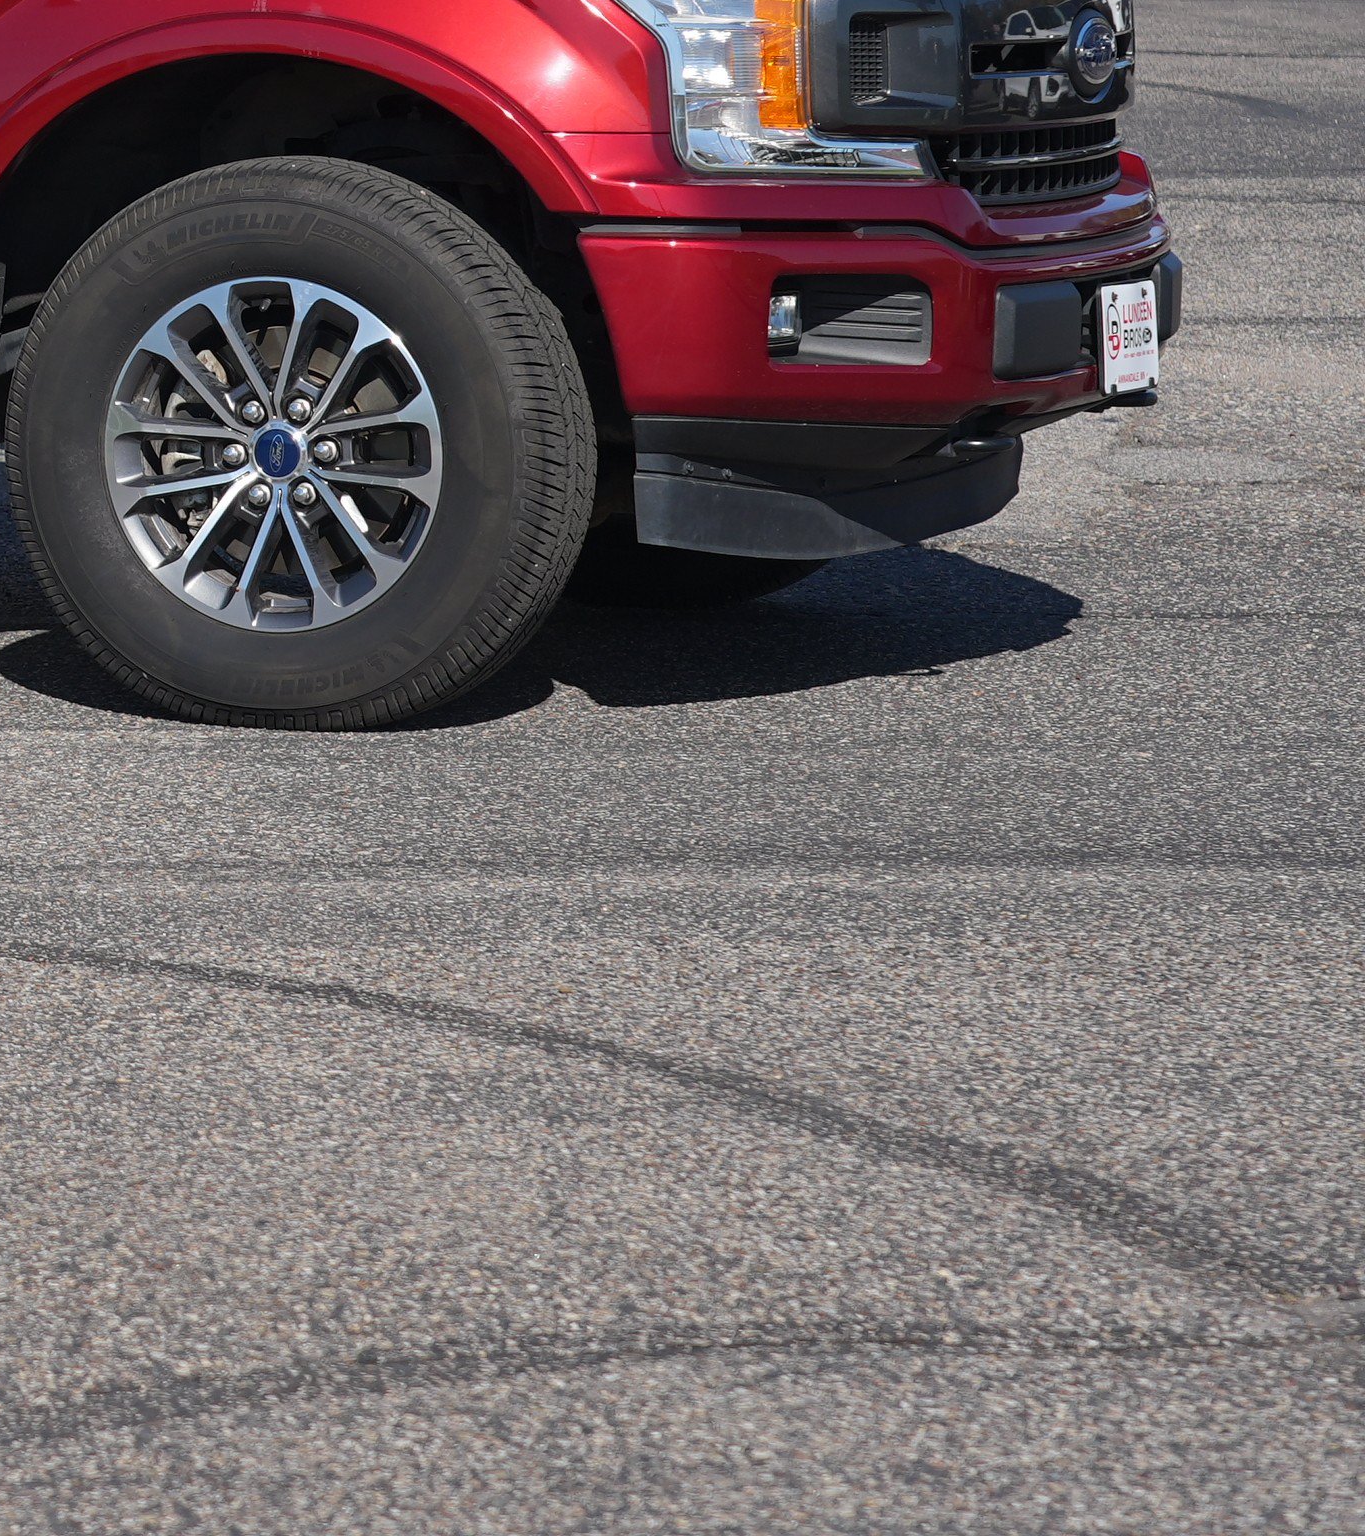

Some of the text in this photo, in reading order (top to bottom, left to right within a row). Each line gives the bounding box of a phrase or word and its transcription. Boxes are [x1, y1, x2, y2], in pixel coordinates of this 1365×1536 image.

[166, 213, 295, 250] MICHELIN
[1122, 301, 1153, 324] LUNDEEN
[1123, 327, 1143, 349] BROS
